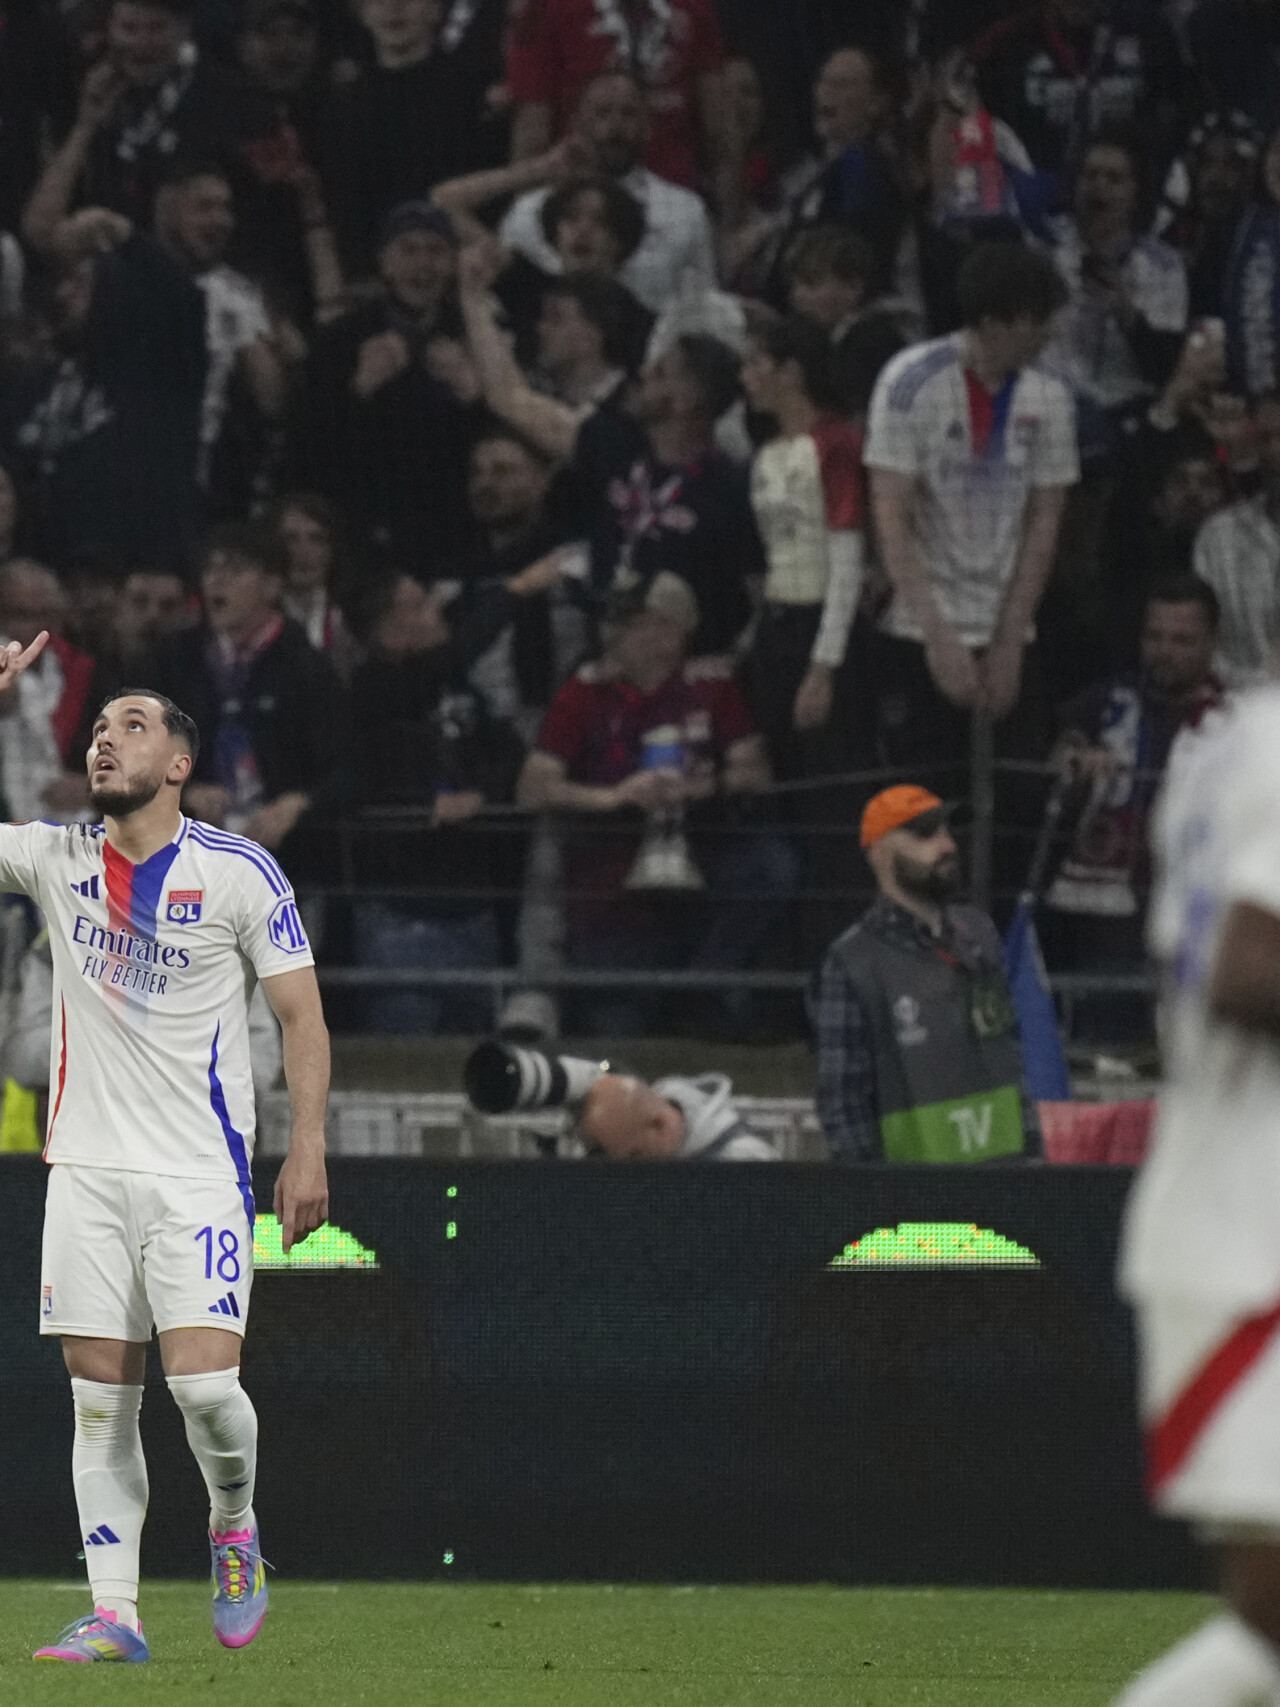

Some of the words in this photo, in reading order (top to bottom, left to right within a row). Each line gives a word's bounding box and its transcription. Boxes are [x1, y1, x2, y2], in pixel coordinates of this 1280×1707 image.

[170, 904, 198, 919] OL
[72, 915, 190, 968] Emirates
[82, 956, 109, 980] FLY
[111, 964, 168, 995] BETTER
[948, 1103, 993, 1152] TV
[194, 1226, 241, 1283] 18
